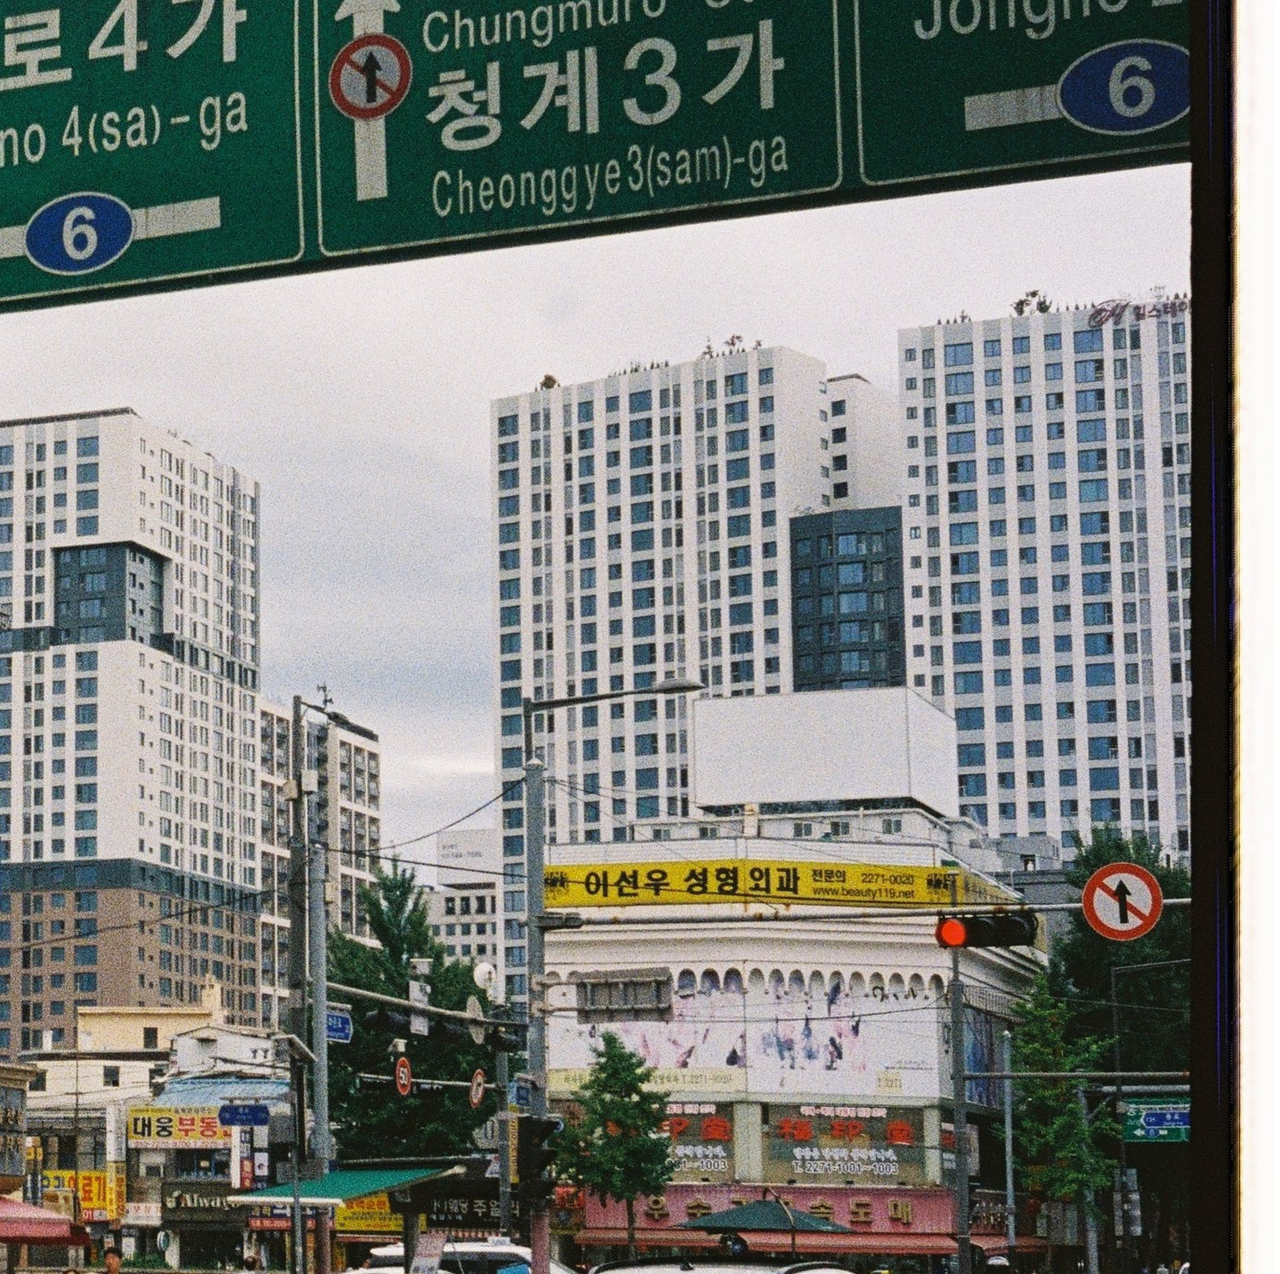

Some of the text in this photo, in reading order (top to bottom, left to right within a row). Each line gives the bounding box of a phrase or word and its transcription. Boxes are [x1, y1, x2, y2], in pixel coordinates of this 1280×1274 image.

[428, 19, 785, 152] 청계3가
[1109, 55, 1156, 118] 6
[432, 135, 789, 219] Cheonggye3(sam)-ga
[61, 205, 99, 260] 6
[585, 869, 670, 899] 이선우
[811, 869, 846, 884] 전문의
[861, 872, 915, 885] 2271-0020
[812, 886, 915, 900] www.beauty119.net
[132, 1116, 231, 1138] 대웅부동
